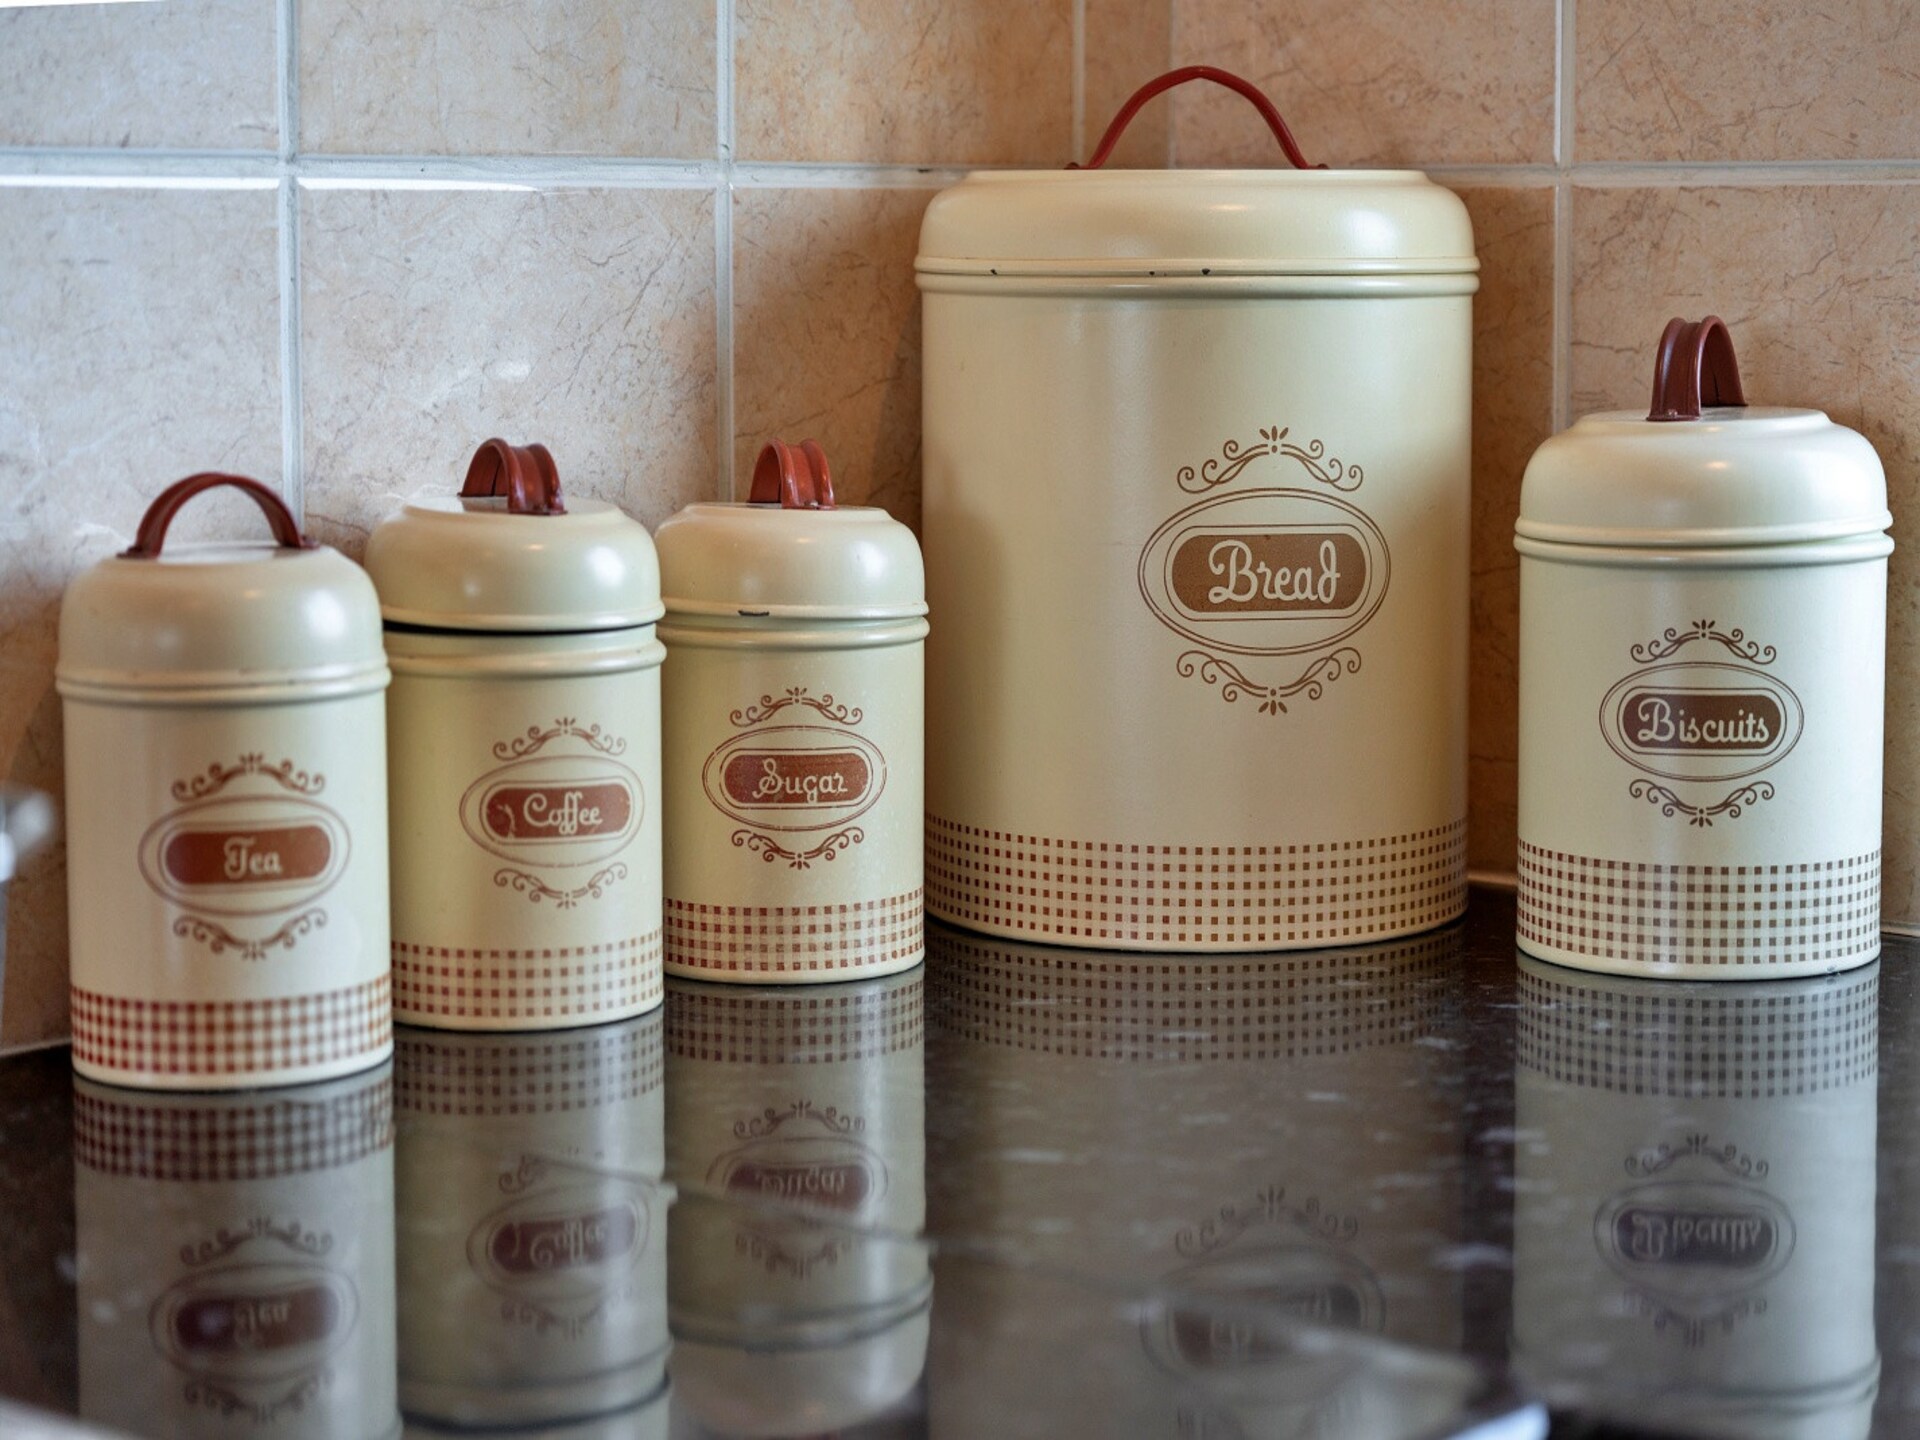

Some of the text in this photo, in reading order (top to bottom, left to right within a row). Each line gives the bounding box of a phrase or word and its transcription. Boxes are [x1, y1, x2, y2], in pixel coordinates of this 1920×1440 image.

[1208, 540, 1340, 603] Bread
[1637, 698, 1769, 742] Biscuits
[752, 758, 848, 804] Sugar
[523, 791, 603, 835] Coffee
[224, 837, 282, 879] Tea
